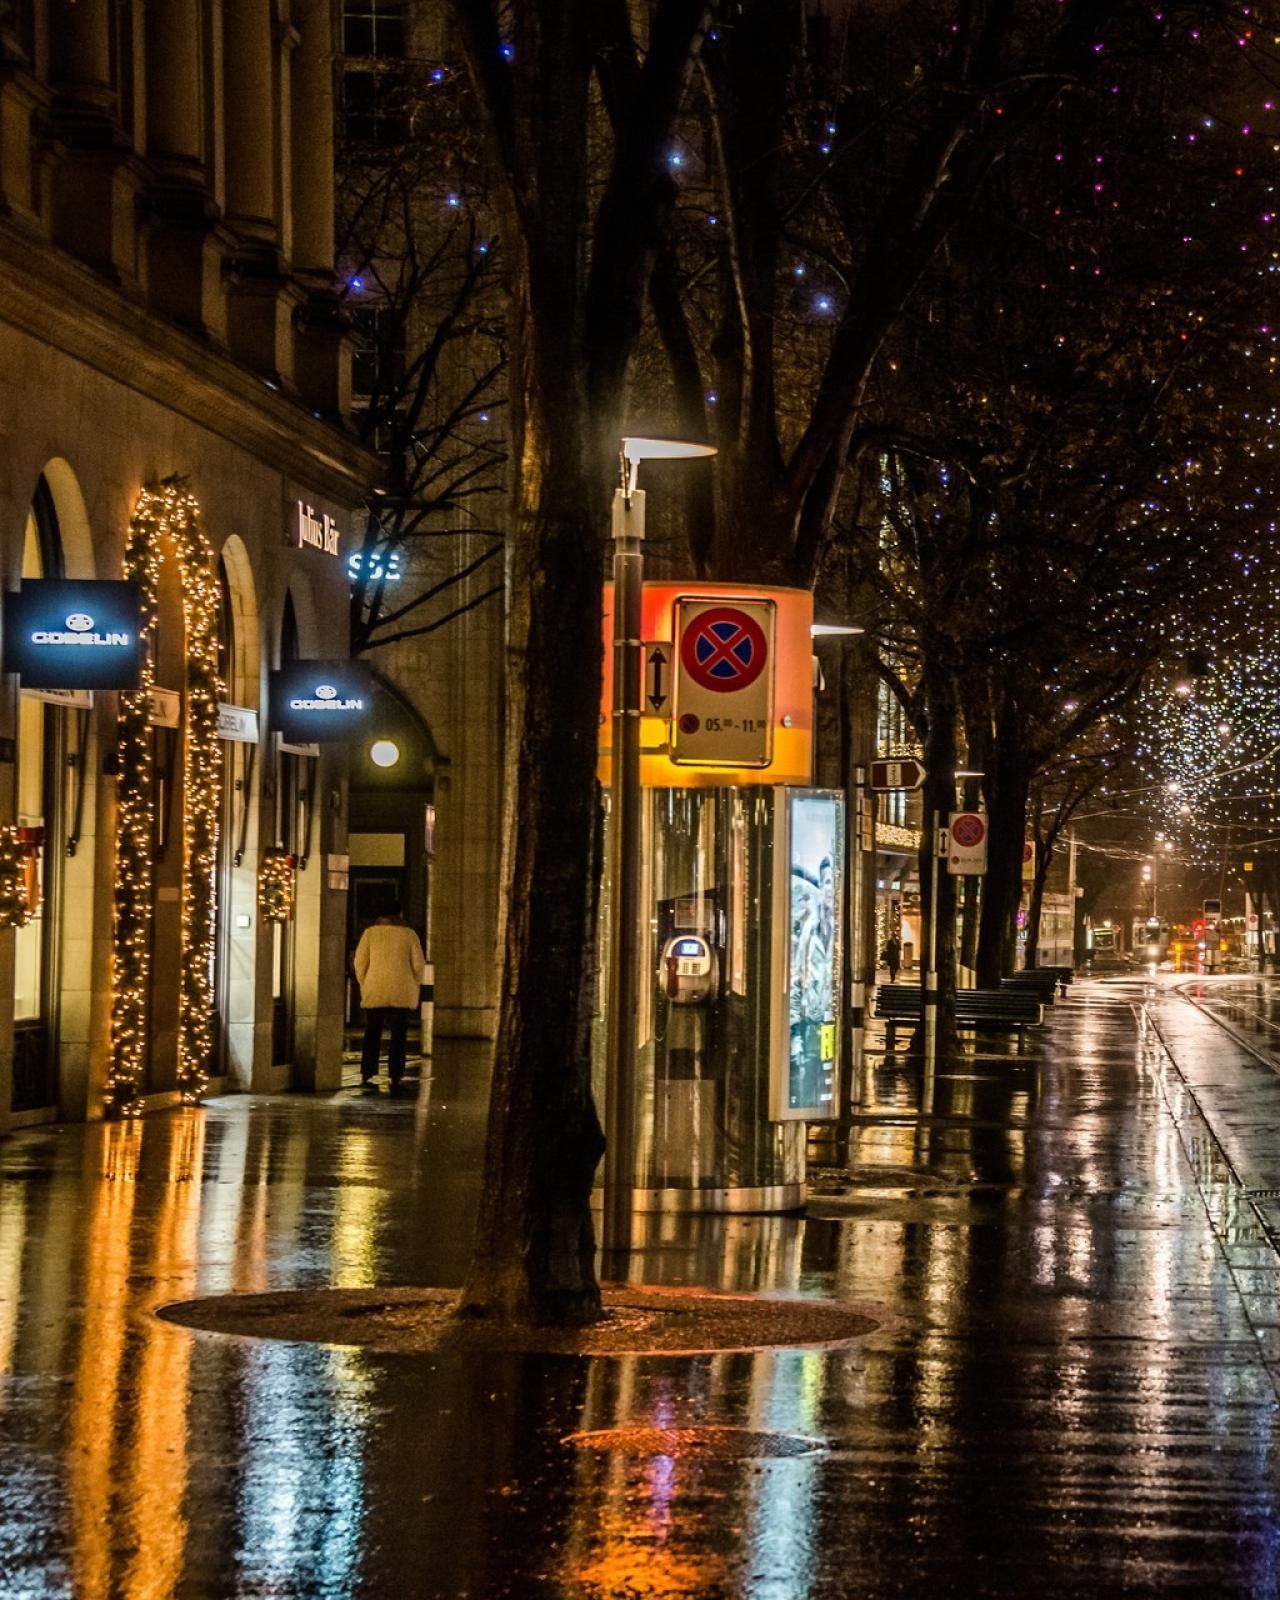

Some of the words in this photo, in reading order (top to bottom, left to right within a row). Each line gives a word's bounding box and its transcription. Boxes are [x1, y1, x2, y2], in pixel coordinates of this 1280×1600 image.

[298, 500, 323, 549] Julius
[323, 513, 341, 556] Bär
[31, 631, 130, 646] GOBELIN
[290, 698, 364, 711] GOBELIN
